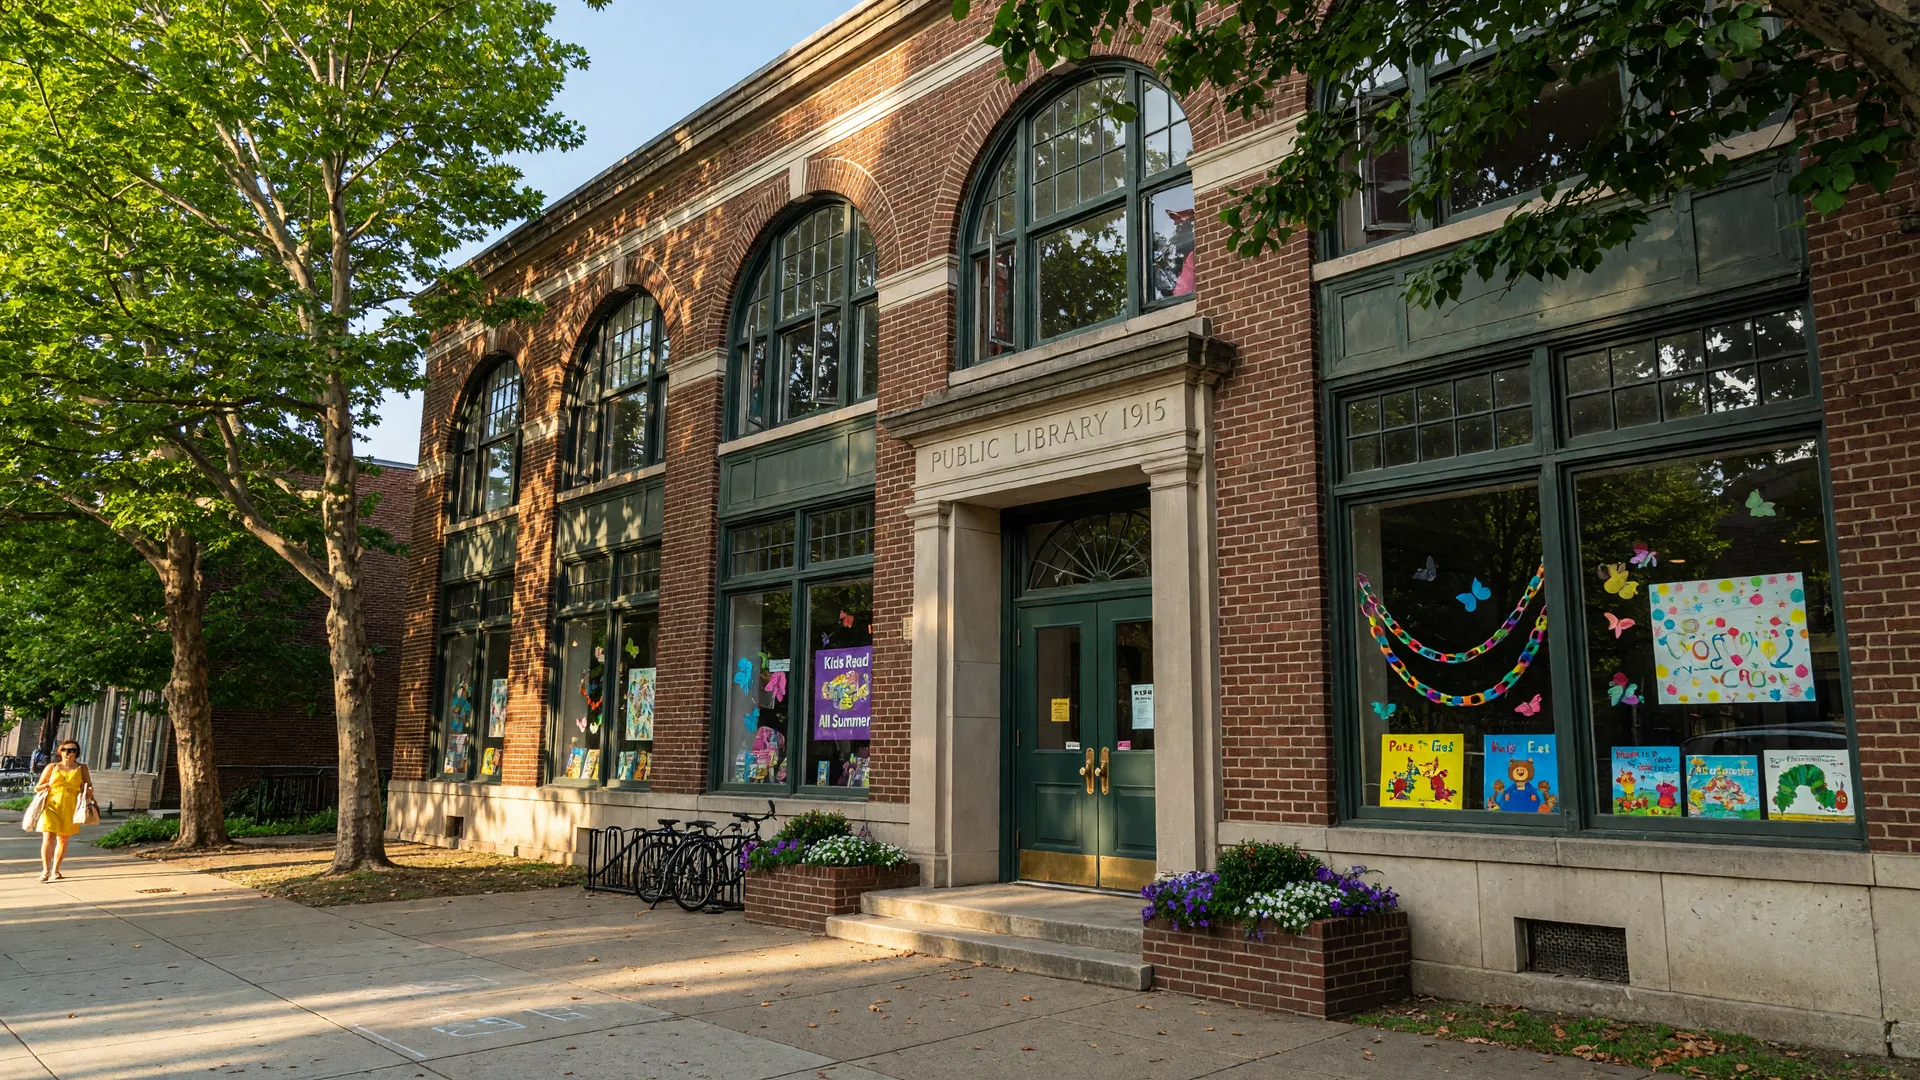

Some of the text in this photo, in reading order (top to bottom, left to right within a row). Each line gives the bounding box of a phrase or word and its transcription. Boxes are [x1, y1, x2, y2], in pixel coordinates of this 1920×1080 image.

[931, 397, 1167, 473] PUBLIC LIBRARY 1915
[824, 653, 869, 670] Kids Read
[819, 714, 871, 728] All Summer
